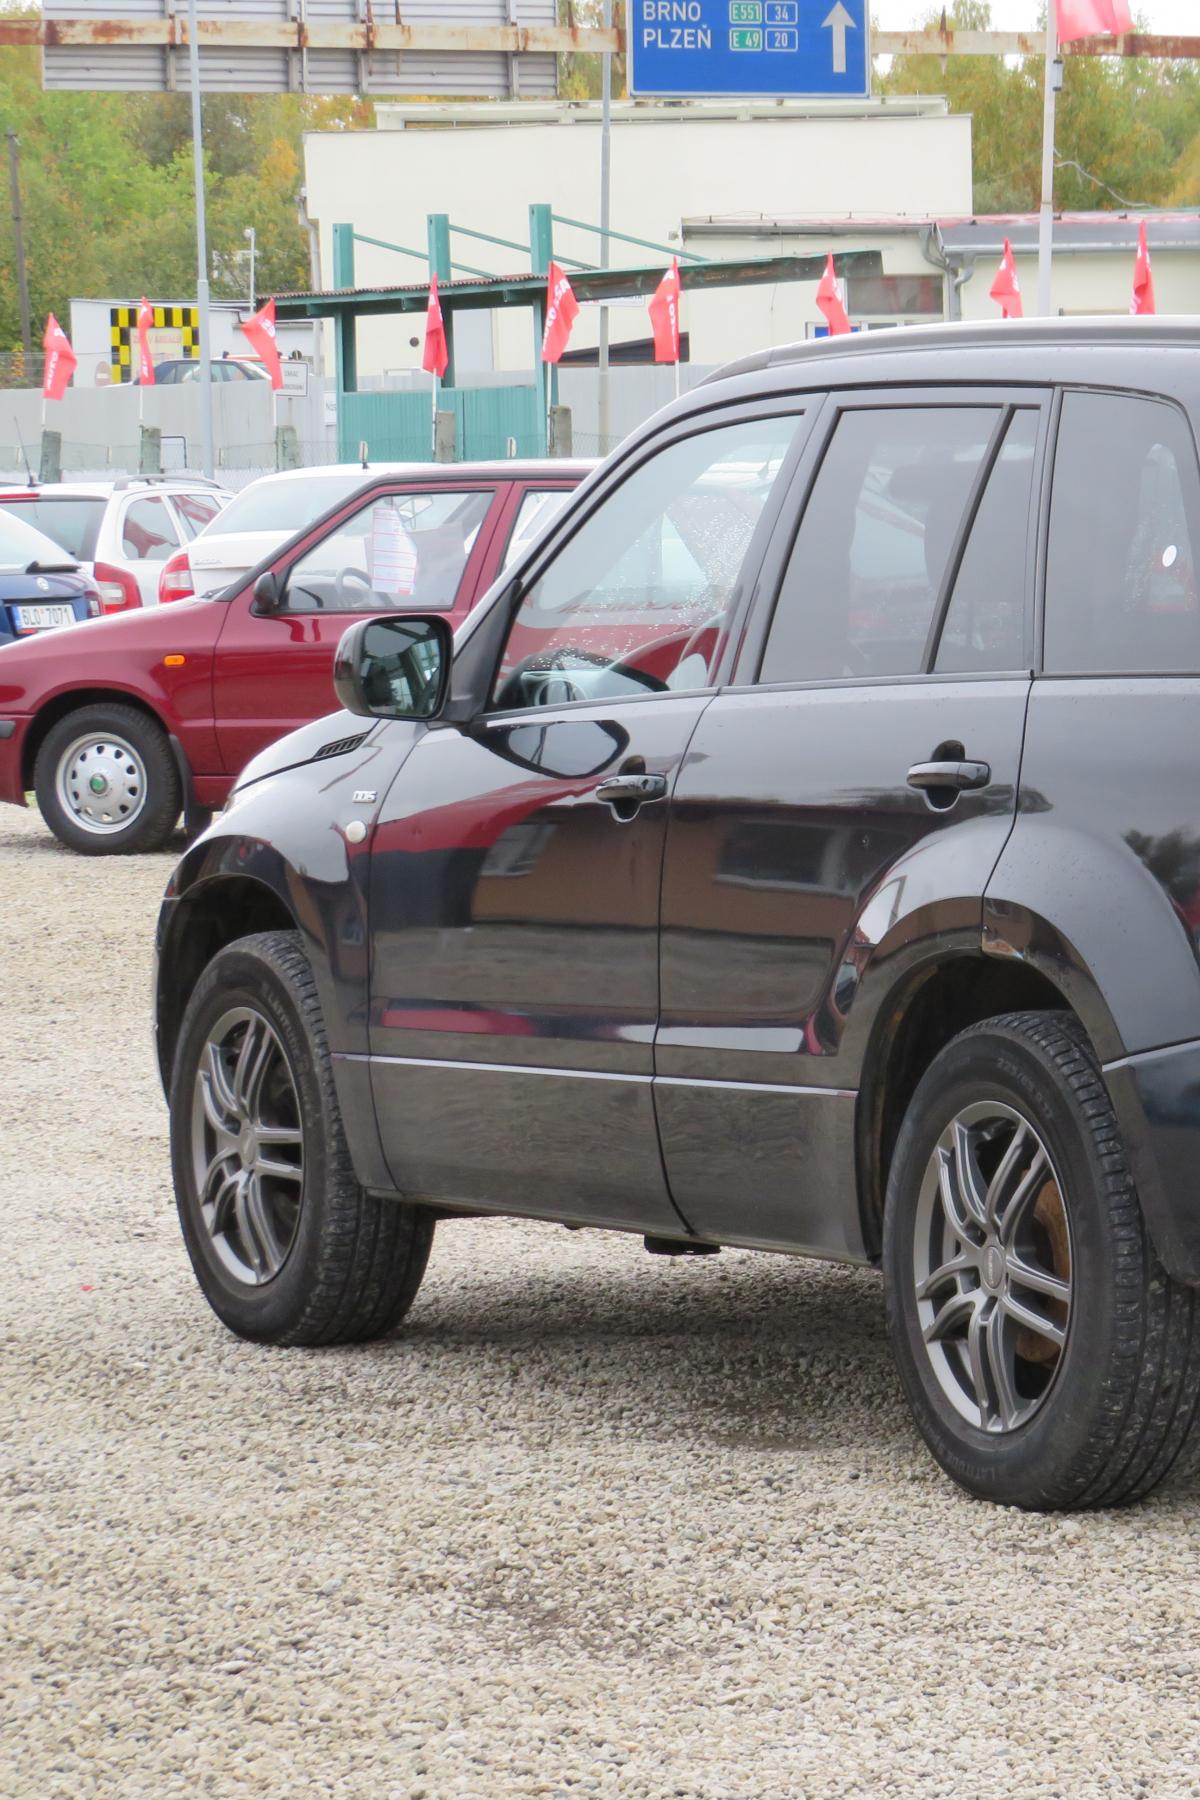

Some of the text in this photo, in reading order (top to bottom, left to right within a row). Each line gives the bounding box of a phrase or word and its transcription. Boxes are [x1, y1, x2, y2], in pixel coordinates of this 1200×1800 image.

[642, 1, 789, 22] BRNO E551 34
[643, 24, 789, 49] PLZEŇ E 49 20
